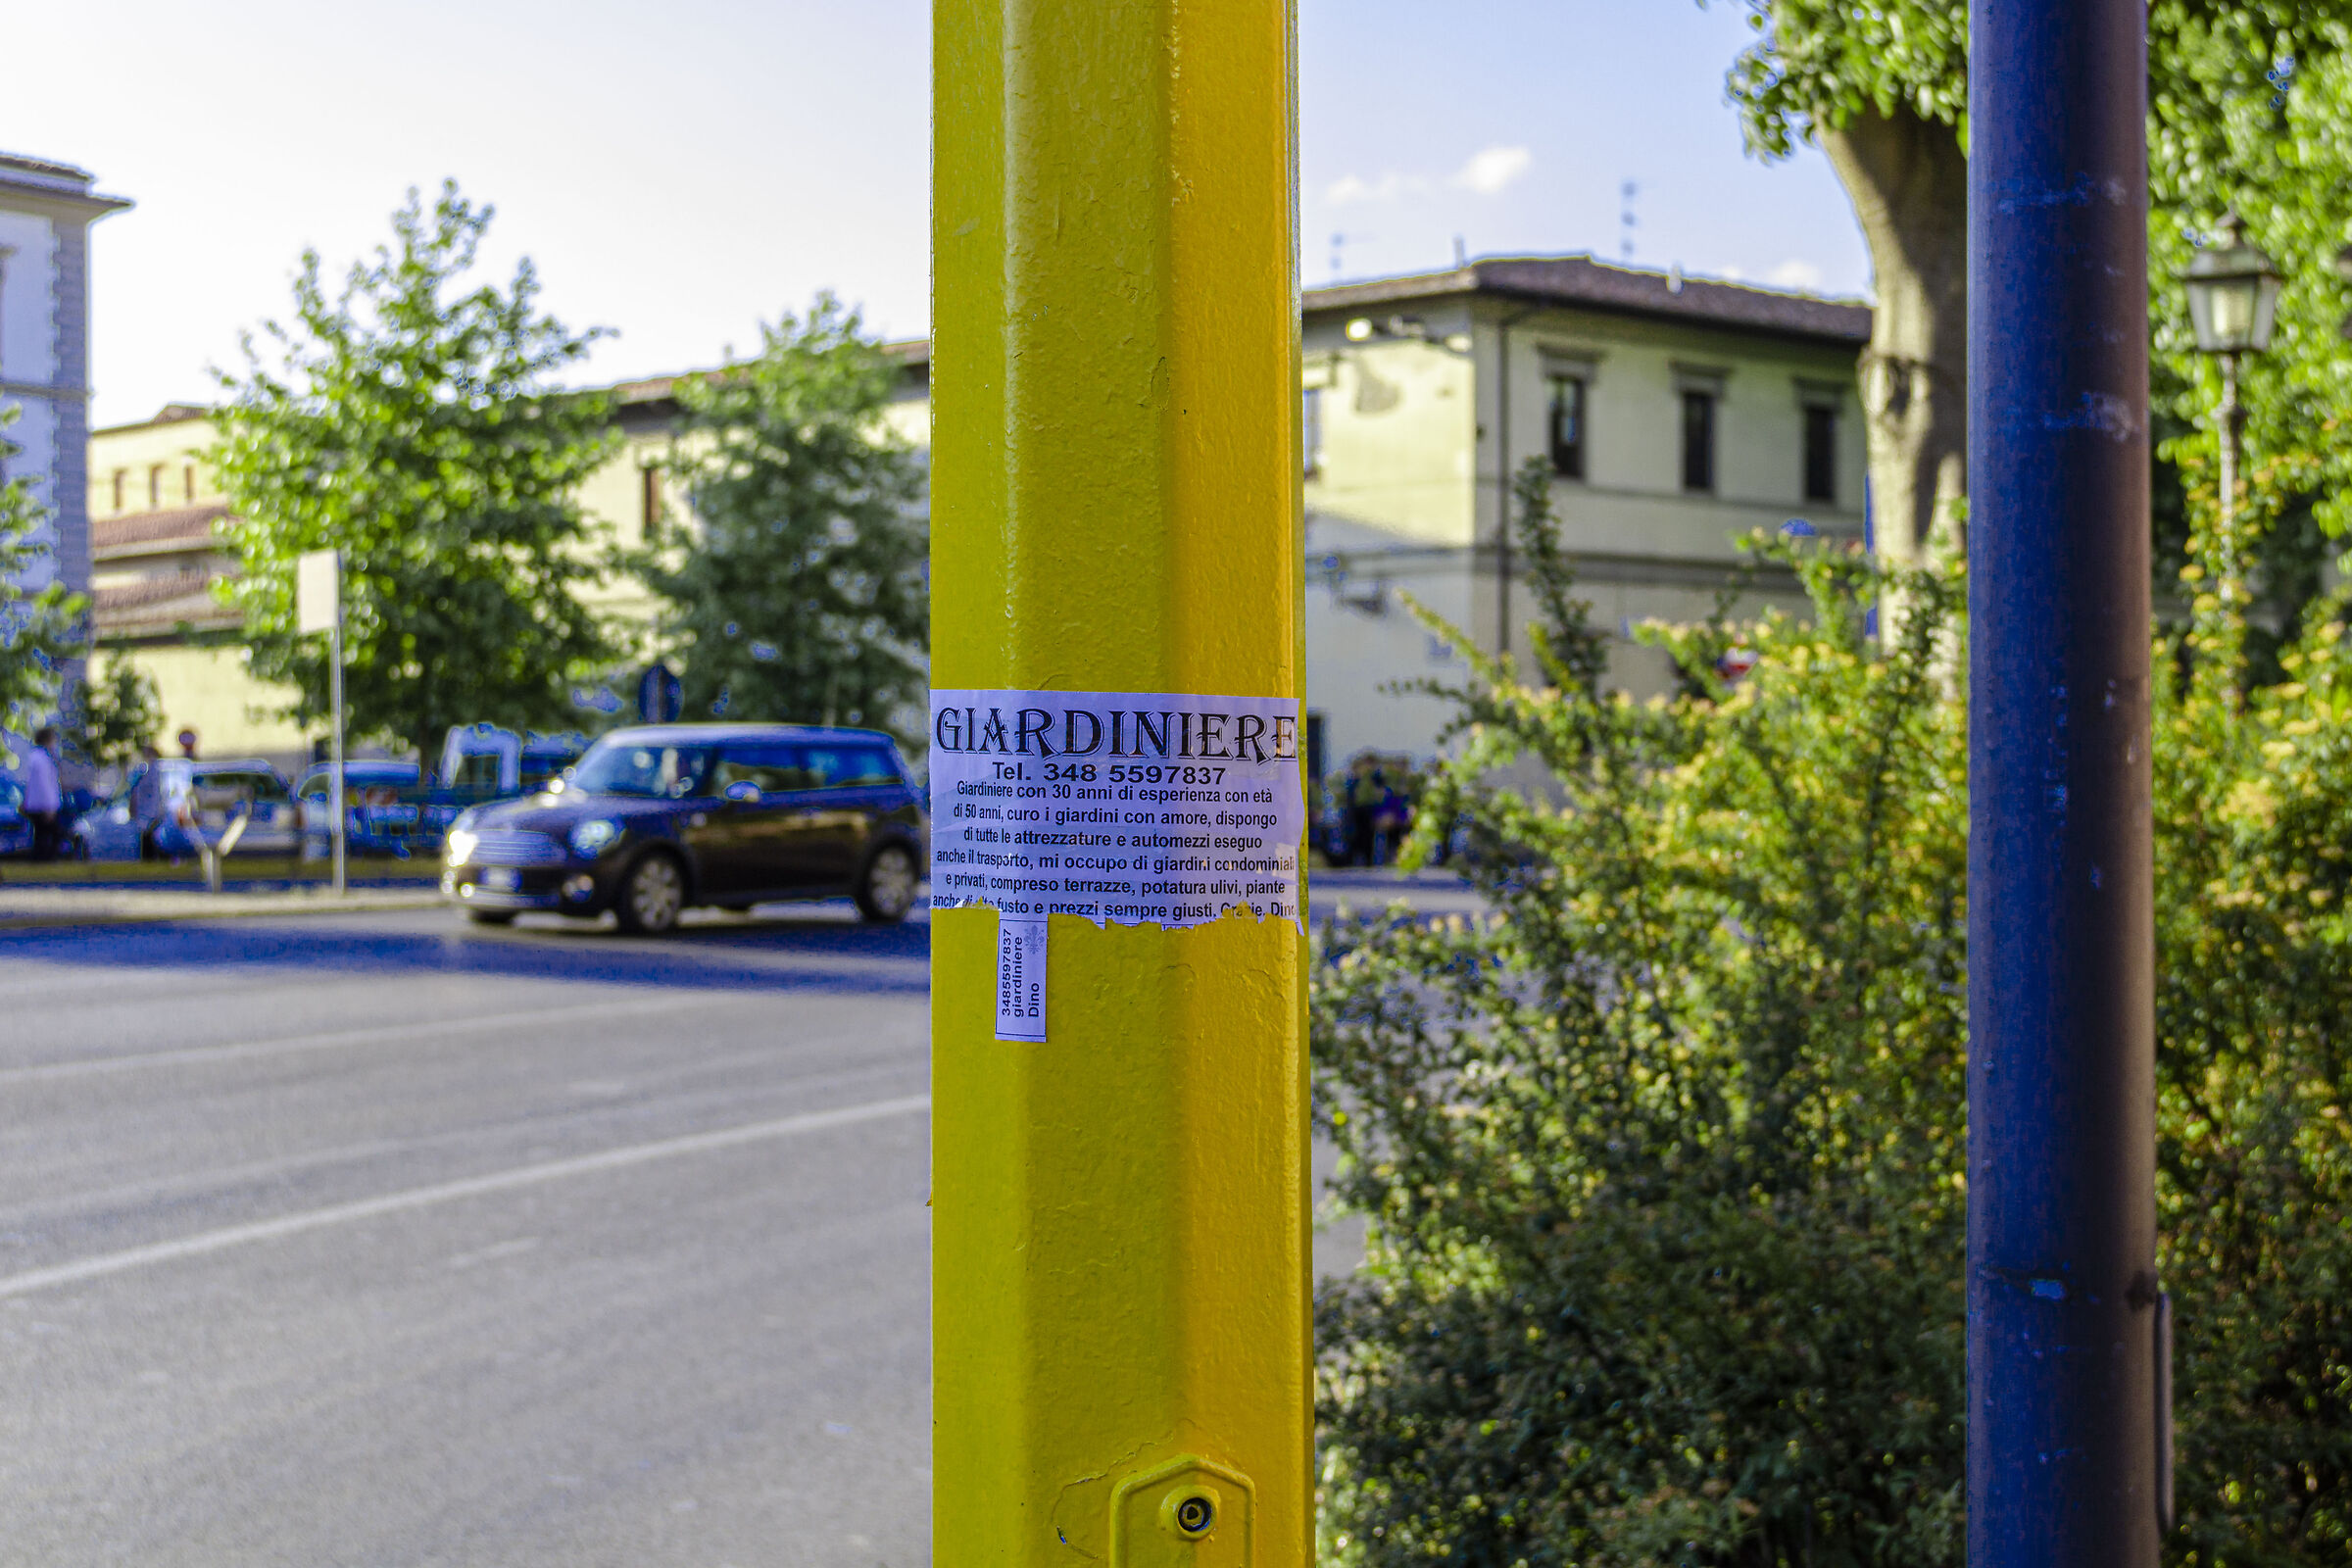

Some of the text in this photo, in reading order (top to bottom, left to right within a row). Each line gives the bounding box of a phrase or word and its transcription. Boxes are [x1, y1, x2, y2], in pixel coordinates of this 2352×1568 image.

[937, 708, 1297, 765] GIARDINIERE
[992, 761, 1226, 784] Tel. 348 5597837
[957, 780, 1272, 805] Giardiniere con 30 anni di esperienza con età
[954, 803, 1278, 829] di 50 anni, curo i giardini con amore, dispongo
[964, 827, 1262, 852] di tutte le attrezzature e automezzi eseguo
[937, 849, 966, 863] anche
[968, 849, 974, 864] il
[977, 851, 1034, 870] trasporto,
[1040, 854, 1058, 868] mi
[1064, 857, 1127, 872] occupo
[1133, 856, 1148, 870] di
[1153, 856, 1210, 874] giardini
[946, 872, 1285, 897] e privati, compreso terrazze, potatura ulivi, piante
[998, 897, 1029, 913] fusto
[1034, 903, 1044, 913] e
[1049, 901, 1099, 916] prezzi
[1104, 904, 1167, 920] sempre
[1173, 903, 1217, 920] giusti.
[1003, 929, 1011, 1015] 3485597837
[1012, 937, 1024, 1017] giardiniere
[1028, 983, 1039, 1017] Dino
